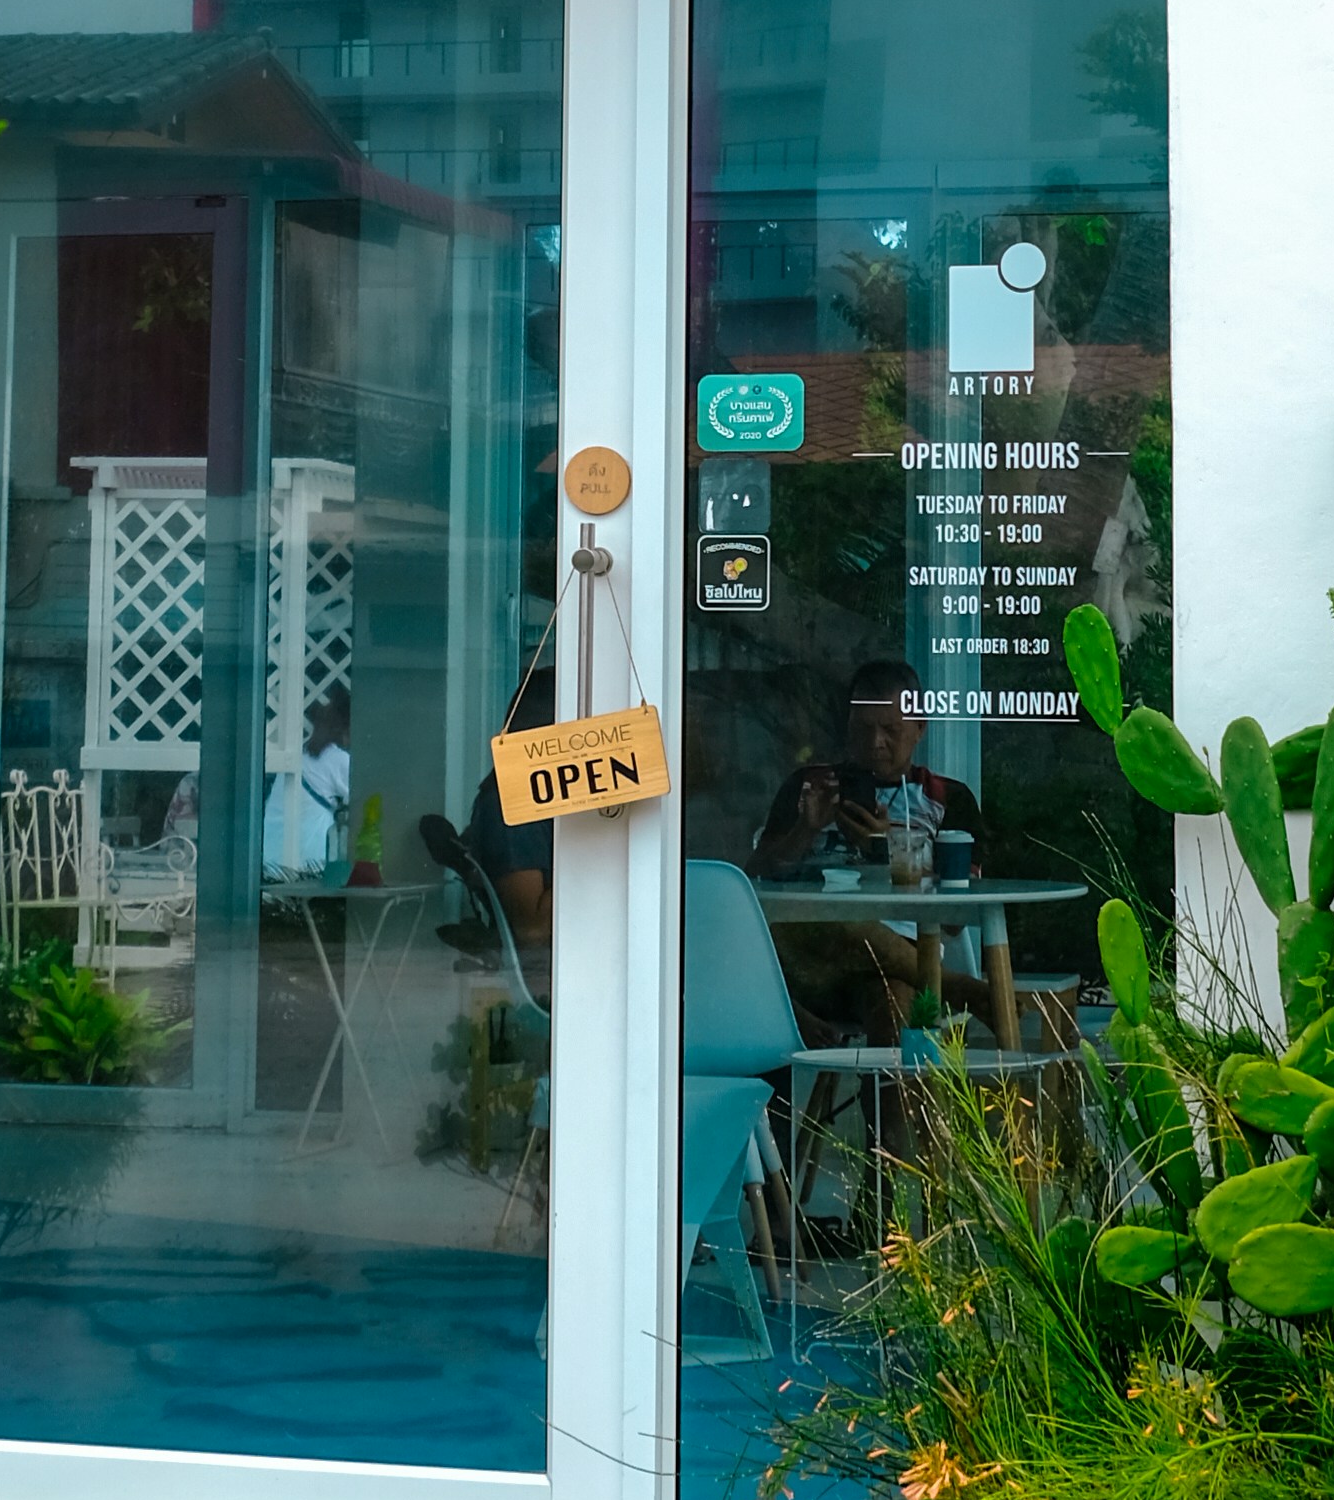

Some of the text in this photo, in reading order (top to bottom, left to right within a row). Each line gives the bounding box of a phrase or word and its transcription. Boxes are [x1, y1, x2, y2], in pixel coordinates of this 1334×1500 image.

[948, 375, 1035, 396] ARTORY
[739, 431, 762, 440] 2020
[900, 441, 1080, 470] OPENING HOURS
[579, 482, 612, 495] PULL
[915, 494, 1068, 515] TUESDAY TO FRIDAY
[935, 523, 981, 543] 10:30
[997, 523, 1043, 544] 19:00
[909, 566, 1078, 587] SATURDAY TO SUNDAY
[942, 595, 979, 615] 9:00
[995, 595, 1042, 616] 19:00
[931, 637, 1050, 655] LAST ORDER 18:30
[899, 689, 1081, 716] CLOSE ON MONDAY
[523, 723, 633, 760] WELCOME
[529, 752, 641, 805] OPEN
